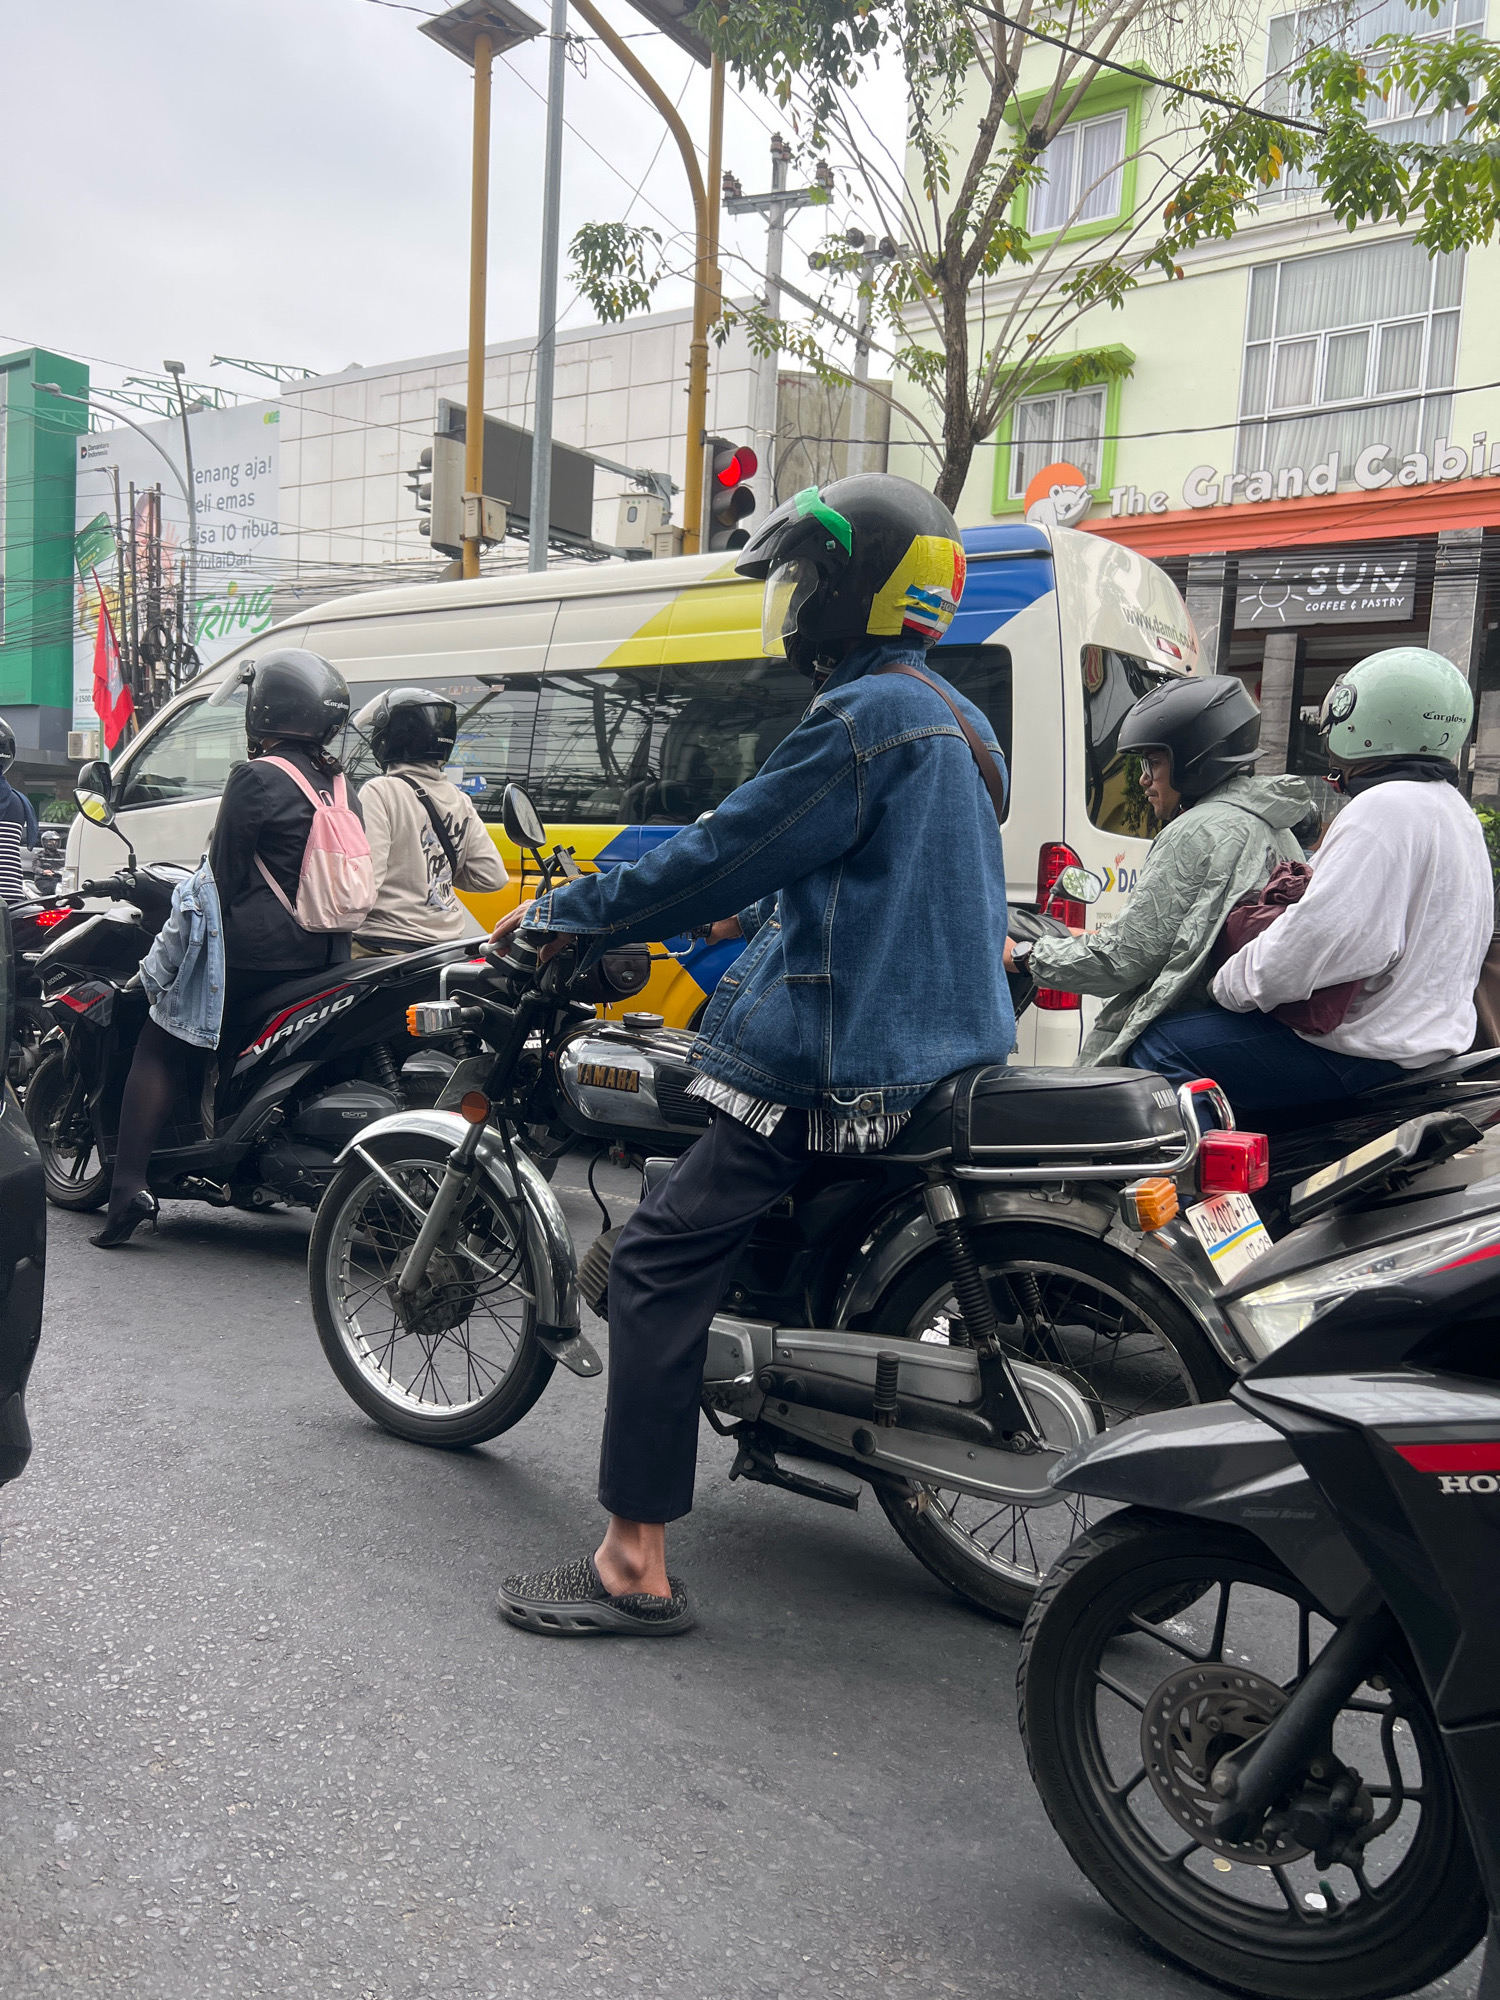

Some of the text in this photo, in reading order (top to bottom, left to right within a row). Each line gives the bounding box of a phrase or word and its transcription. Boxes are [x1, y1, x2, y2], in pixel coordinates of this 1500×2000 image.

[193, 456, 272, 487] enang aja!
[1109, 485, 1168, 518] The
[1182, 451, 1340, 509] Grand
[195, 492, 255, 513] eli emas
[196, 526, 216, 545] isa
[1307, 561, 1408, 595] SUN
[1305, 600, 1347, 612] COFFEE
[1361, 597, 1405, 609] PASTRY
[1422, 710, 1467, 724] Cargloss
[1118, 868, 1142, 893] DA
[46, 971, 67, 986] HONDA
[252, 994, 355, 1056] VARIO
[577, 1063, 640, 1093] YAMAHA
[1437, 1474, 1500, 1495] HO
